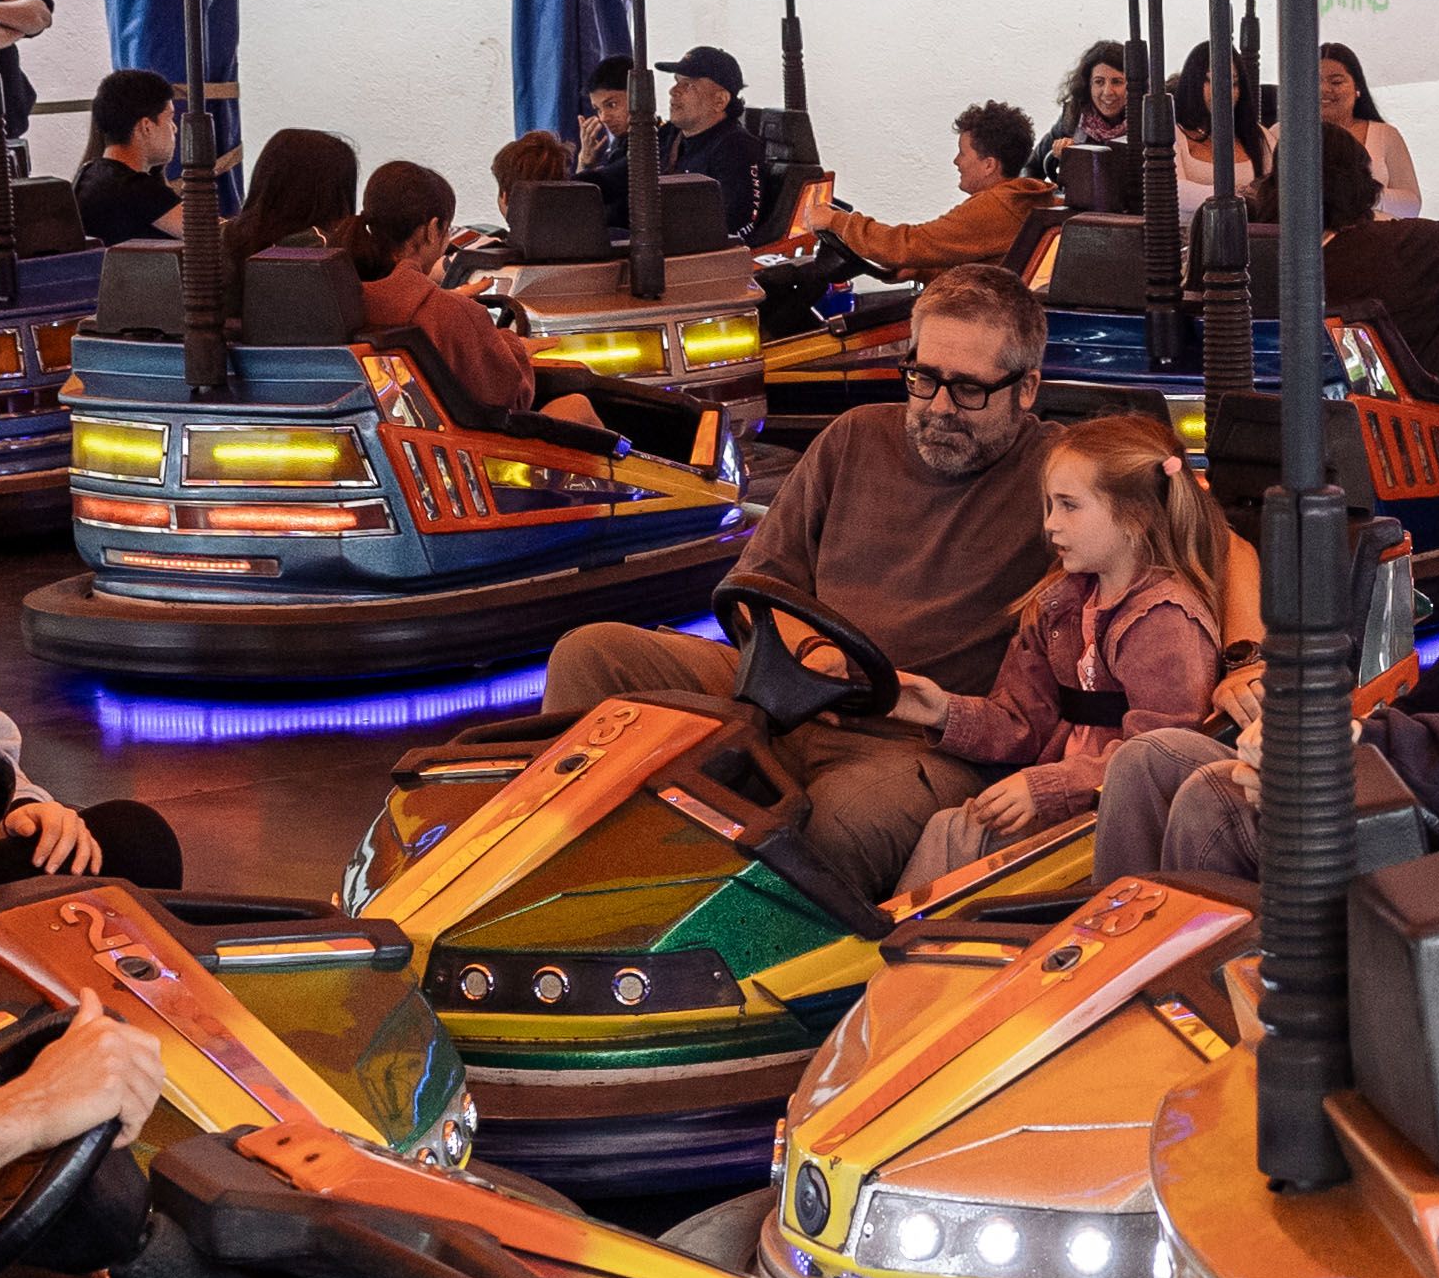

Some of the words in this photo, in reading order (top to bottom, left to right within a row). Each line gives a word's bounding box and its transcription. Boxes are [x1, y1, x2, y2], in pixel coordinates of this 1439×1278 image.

[750, 164, 761, 208] TOMMY
[588, 706, 641, 746] 3
[59, 901, 133, 952] 2
